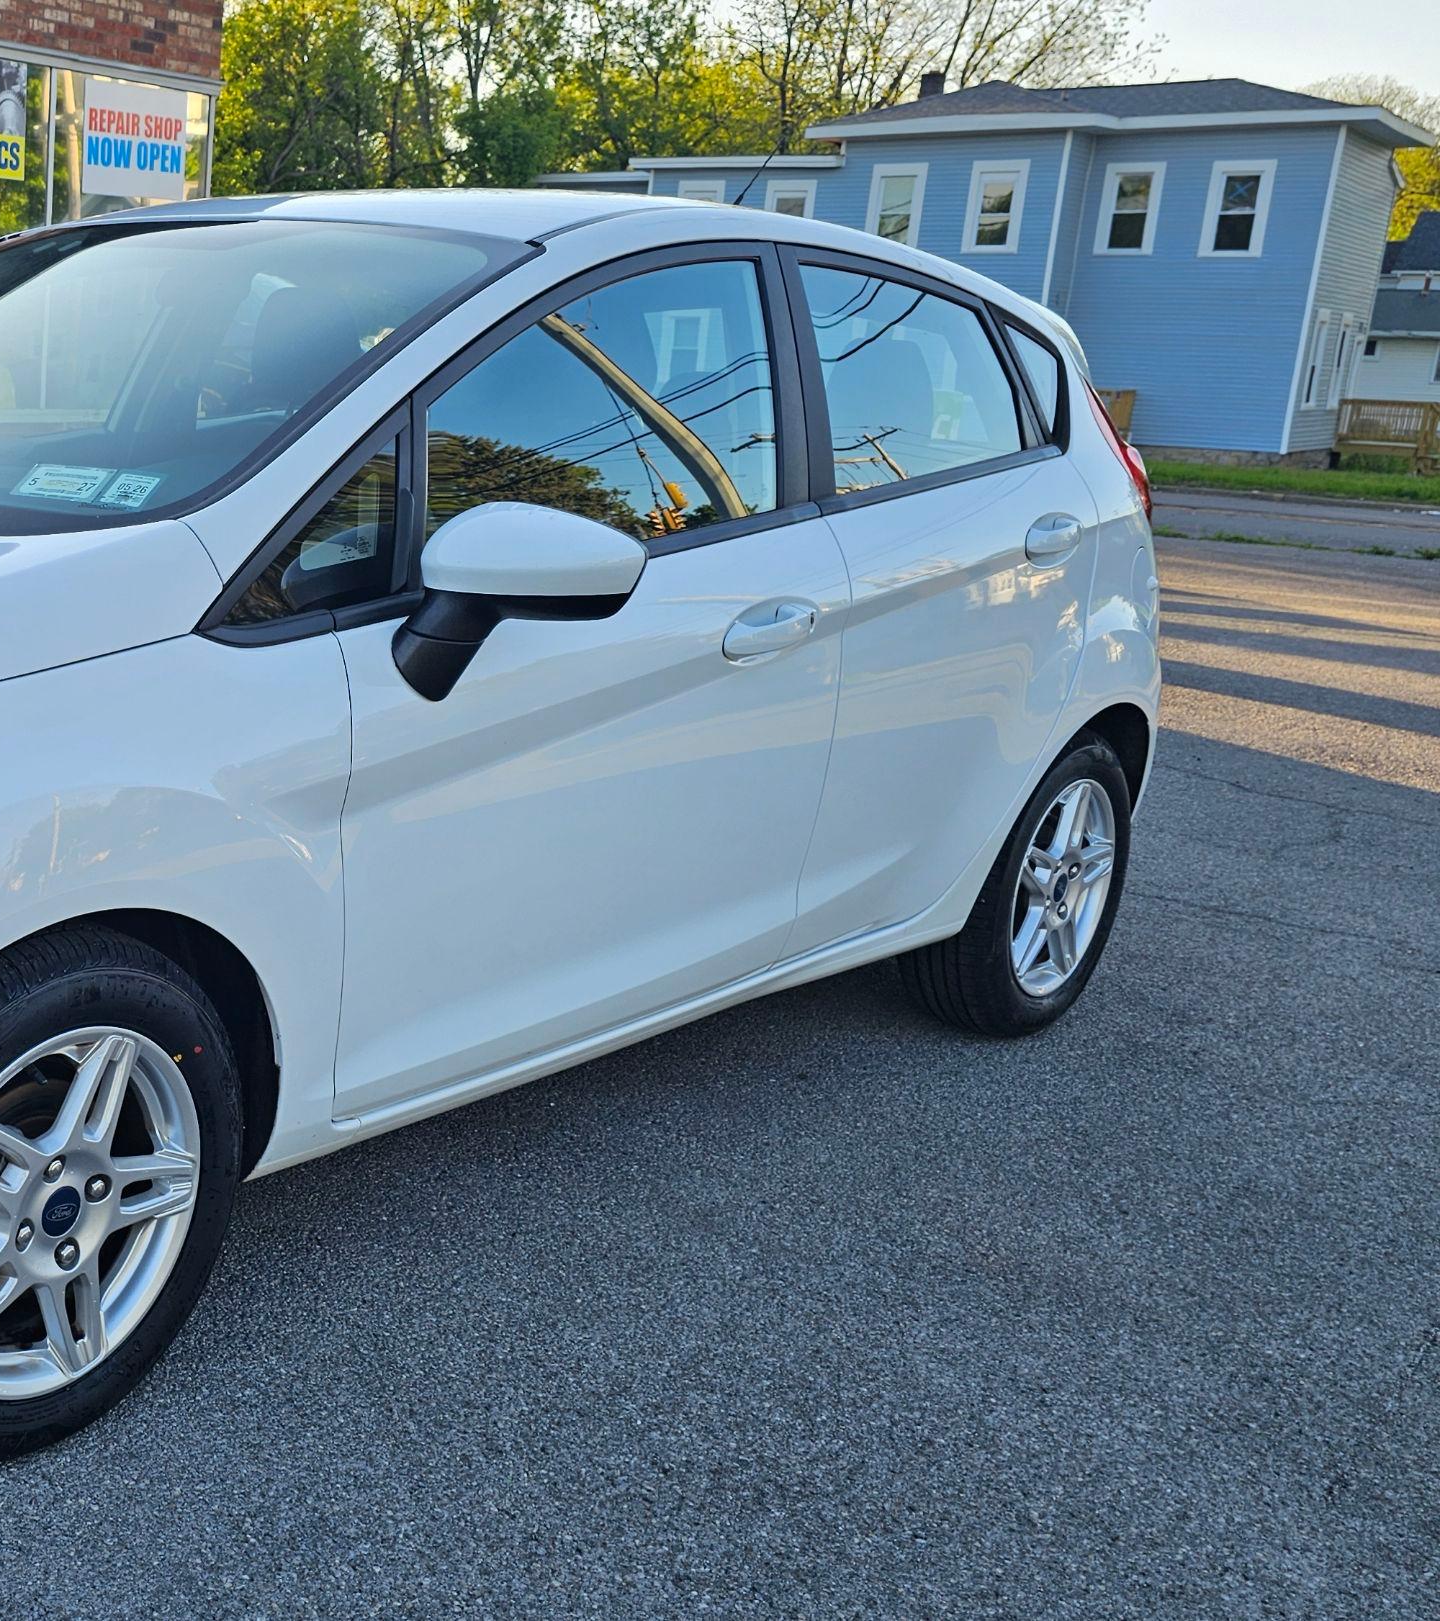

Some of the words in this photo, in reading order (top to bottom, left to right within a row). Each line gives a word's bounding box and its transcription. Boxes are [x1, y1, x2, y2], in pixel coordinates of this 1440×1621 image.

[88, 107, 140, 137] REPAIR
[144, 114, 182, 141] SHOP
[87, 135, 133, 169] NOW
[136, 141, 182, 174] OPEN
[28, 477, 40, 486] 5
[77, 482, 97, 492] 27
[117, 482, 131, 491] 05
[133, 485, 149, 494] 26
